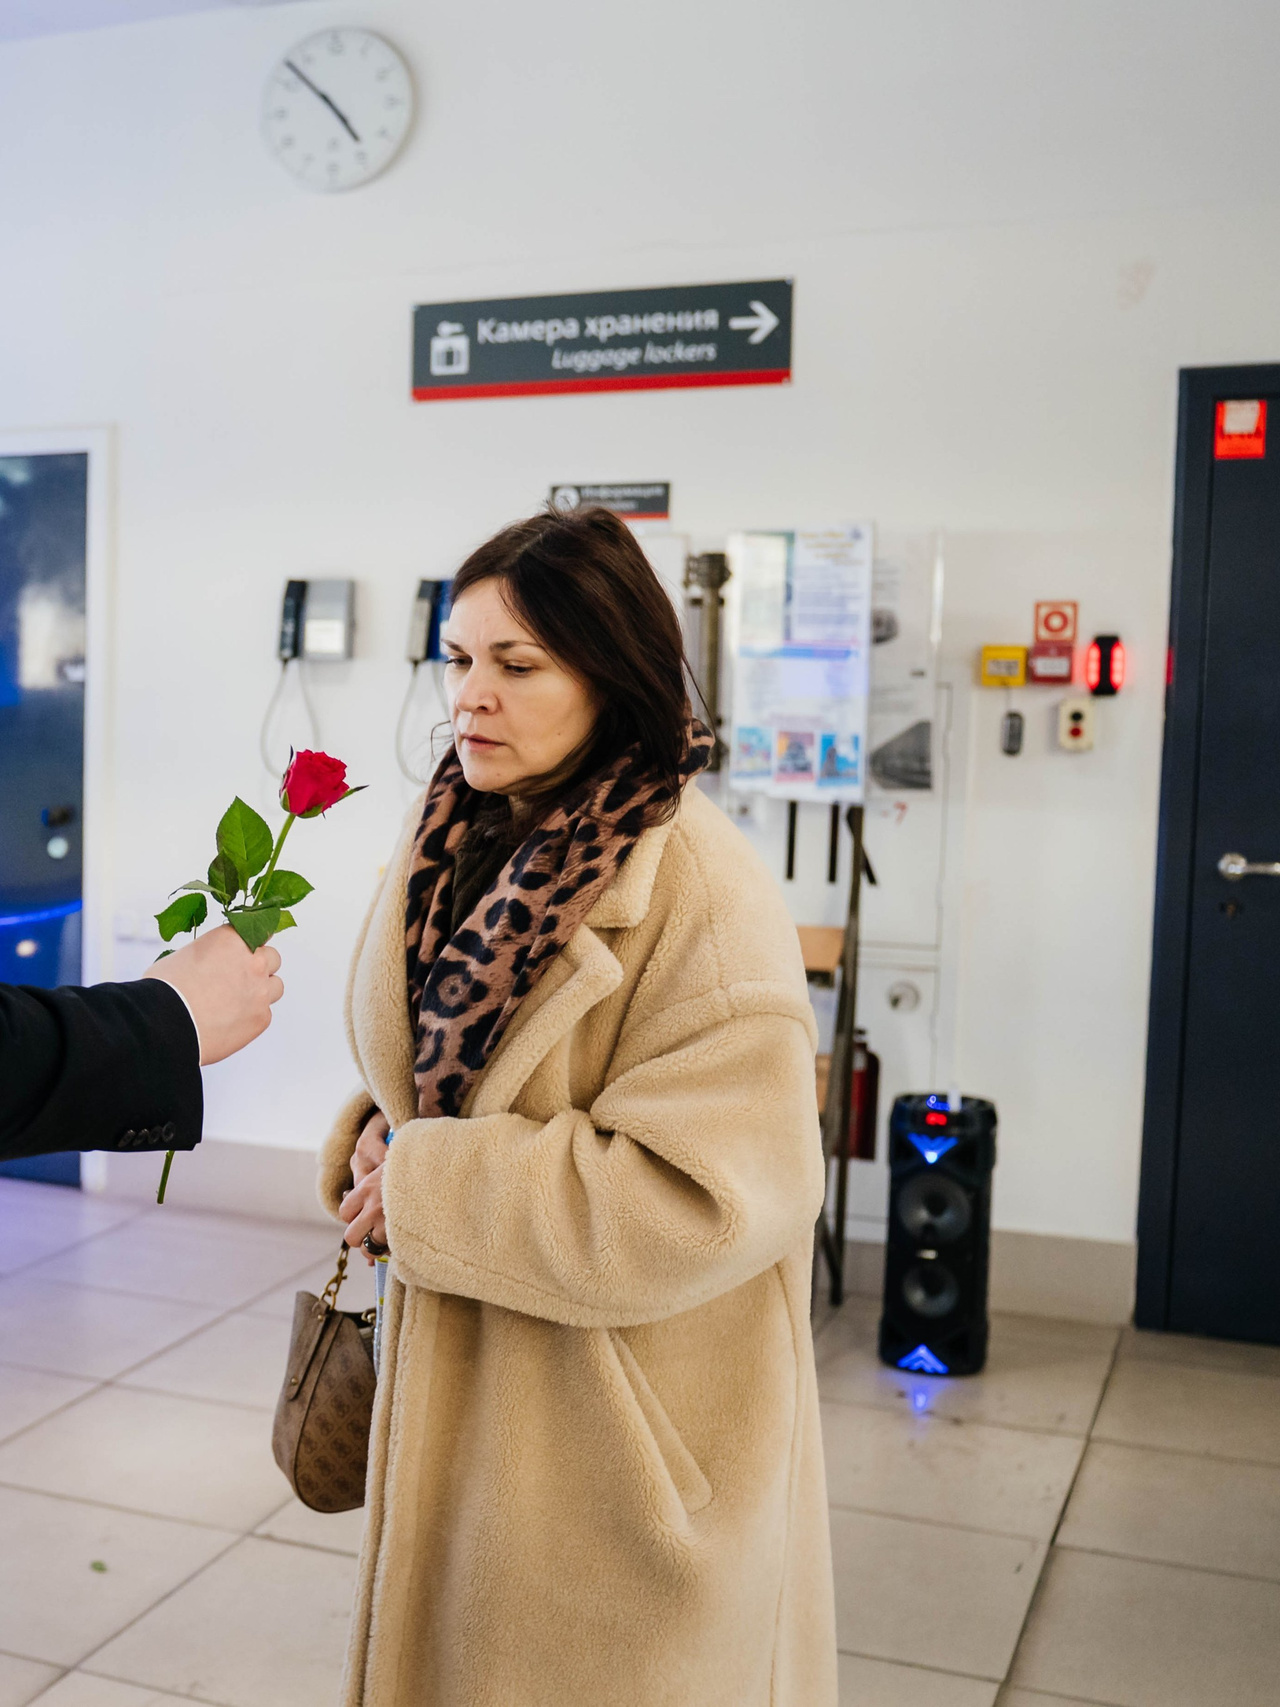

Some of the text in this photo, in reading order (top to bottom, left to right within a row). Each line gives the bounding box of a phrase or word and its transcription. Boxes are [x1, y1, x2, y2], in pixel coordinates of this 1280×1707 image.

[477, 308, 719, 346] Камера хранения
[551, 339, 718, 373] Luggage lockers
